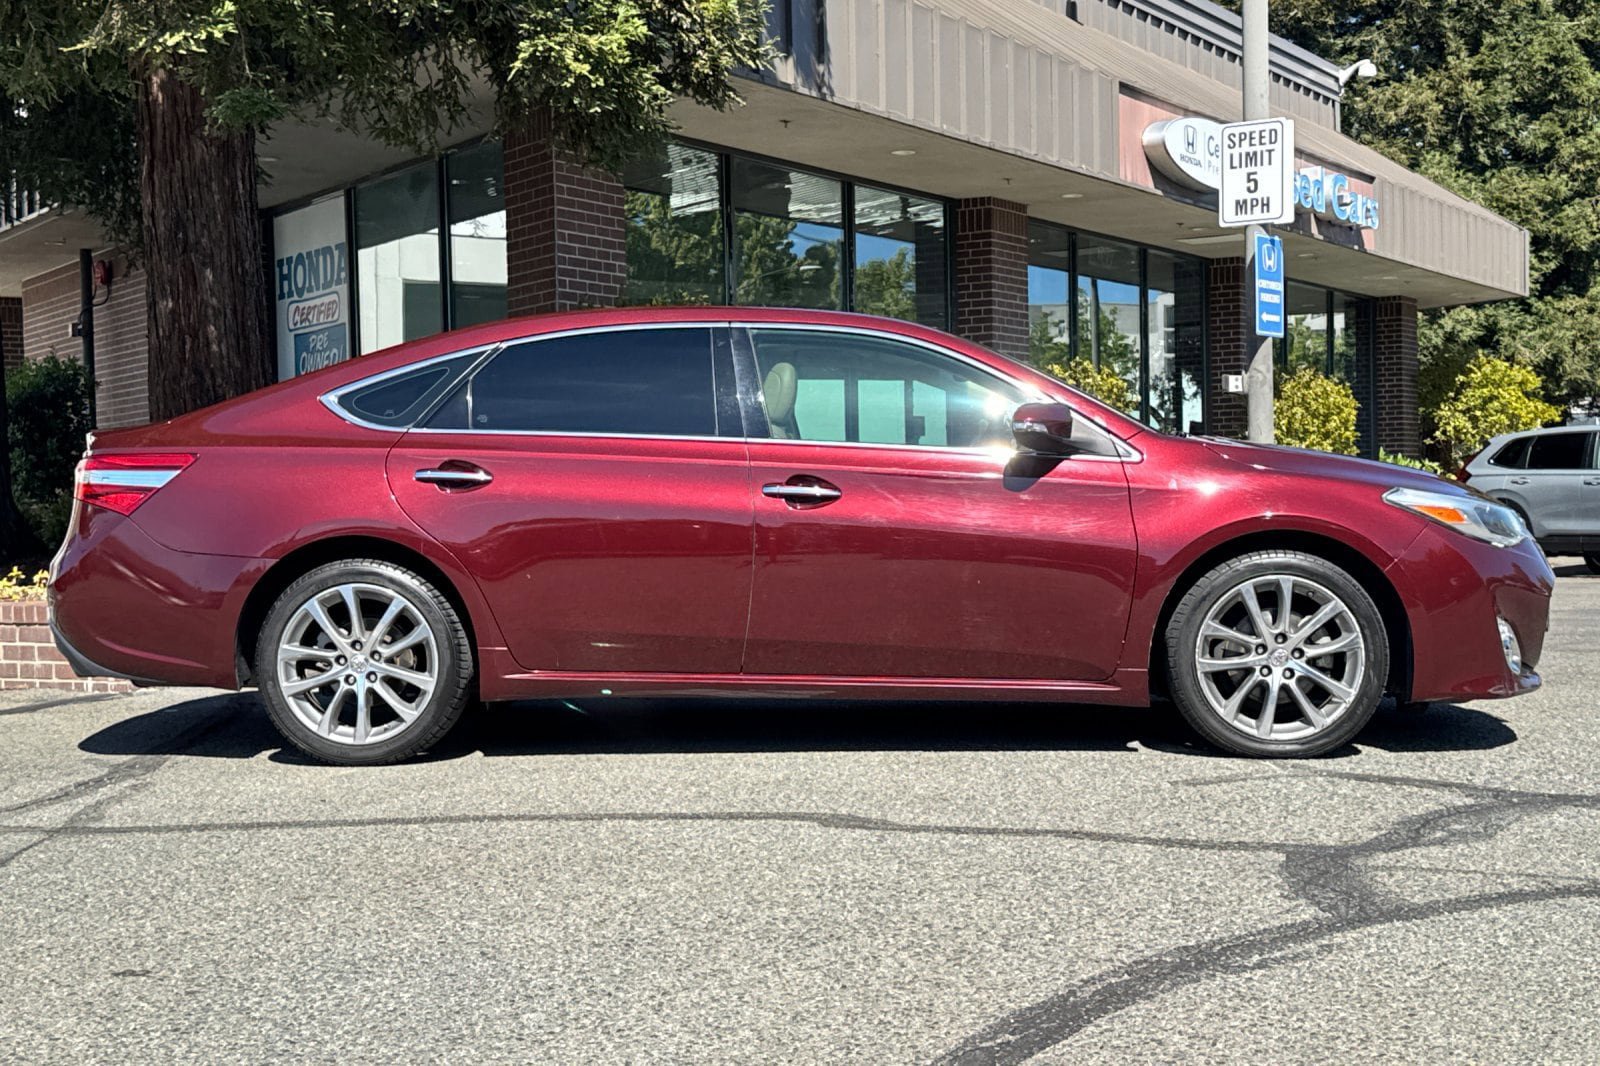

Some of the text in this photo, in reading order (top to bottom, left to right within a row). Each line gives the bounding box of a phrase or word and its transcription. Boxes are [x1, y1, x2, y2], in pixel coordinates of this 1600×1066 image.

[1227, 128, 1278, 149] SPEED
[1229, 149, 1275, 169] LIMIT
[1246, 171, 1258, 194] 5
[1235, 196, 1270, 216] MPH
[1332, 173, 1378, 229] Cars
[277, 242, 346, 301] HONDA
[292, 300, 337, 327] CERTIFIED
[309, 332, 329, 352] PRE
